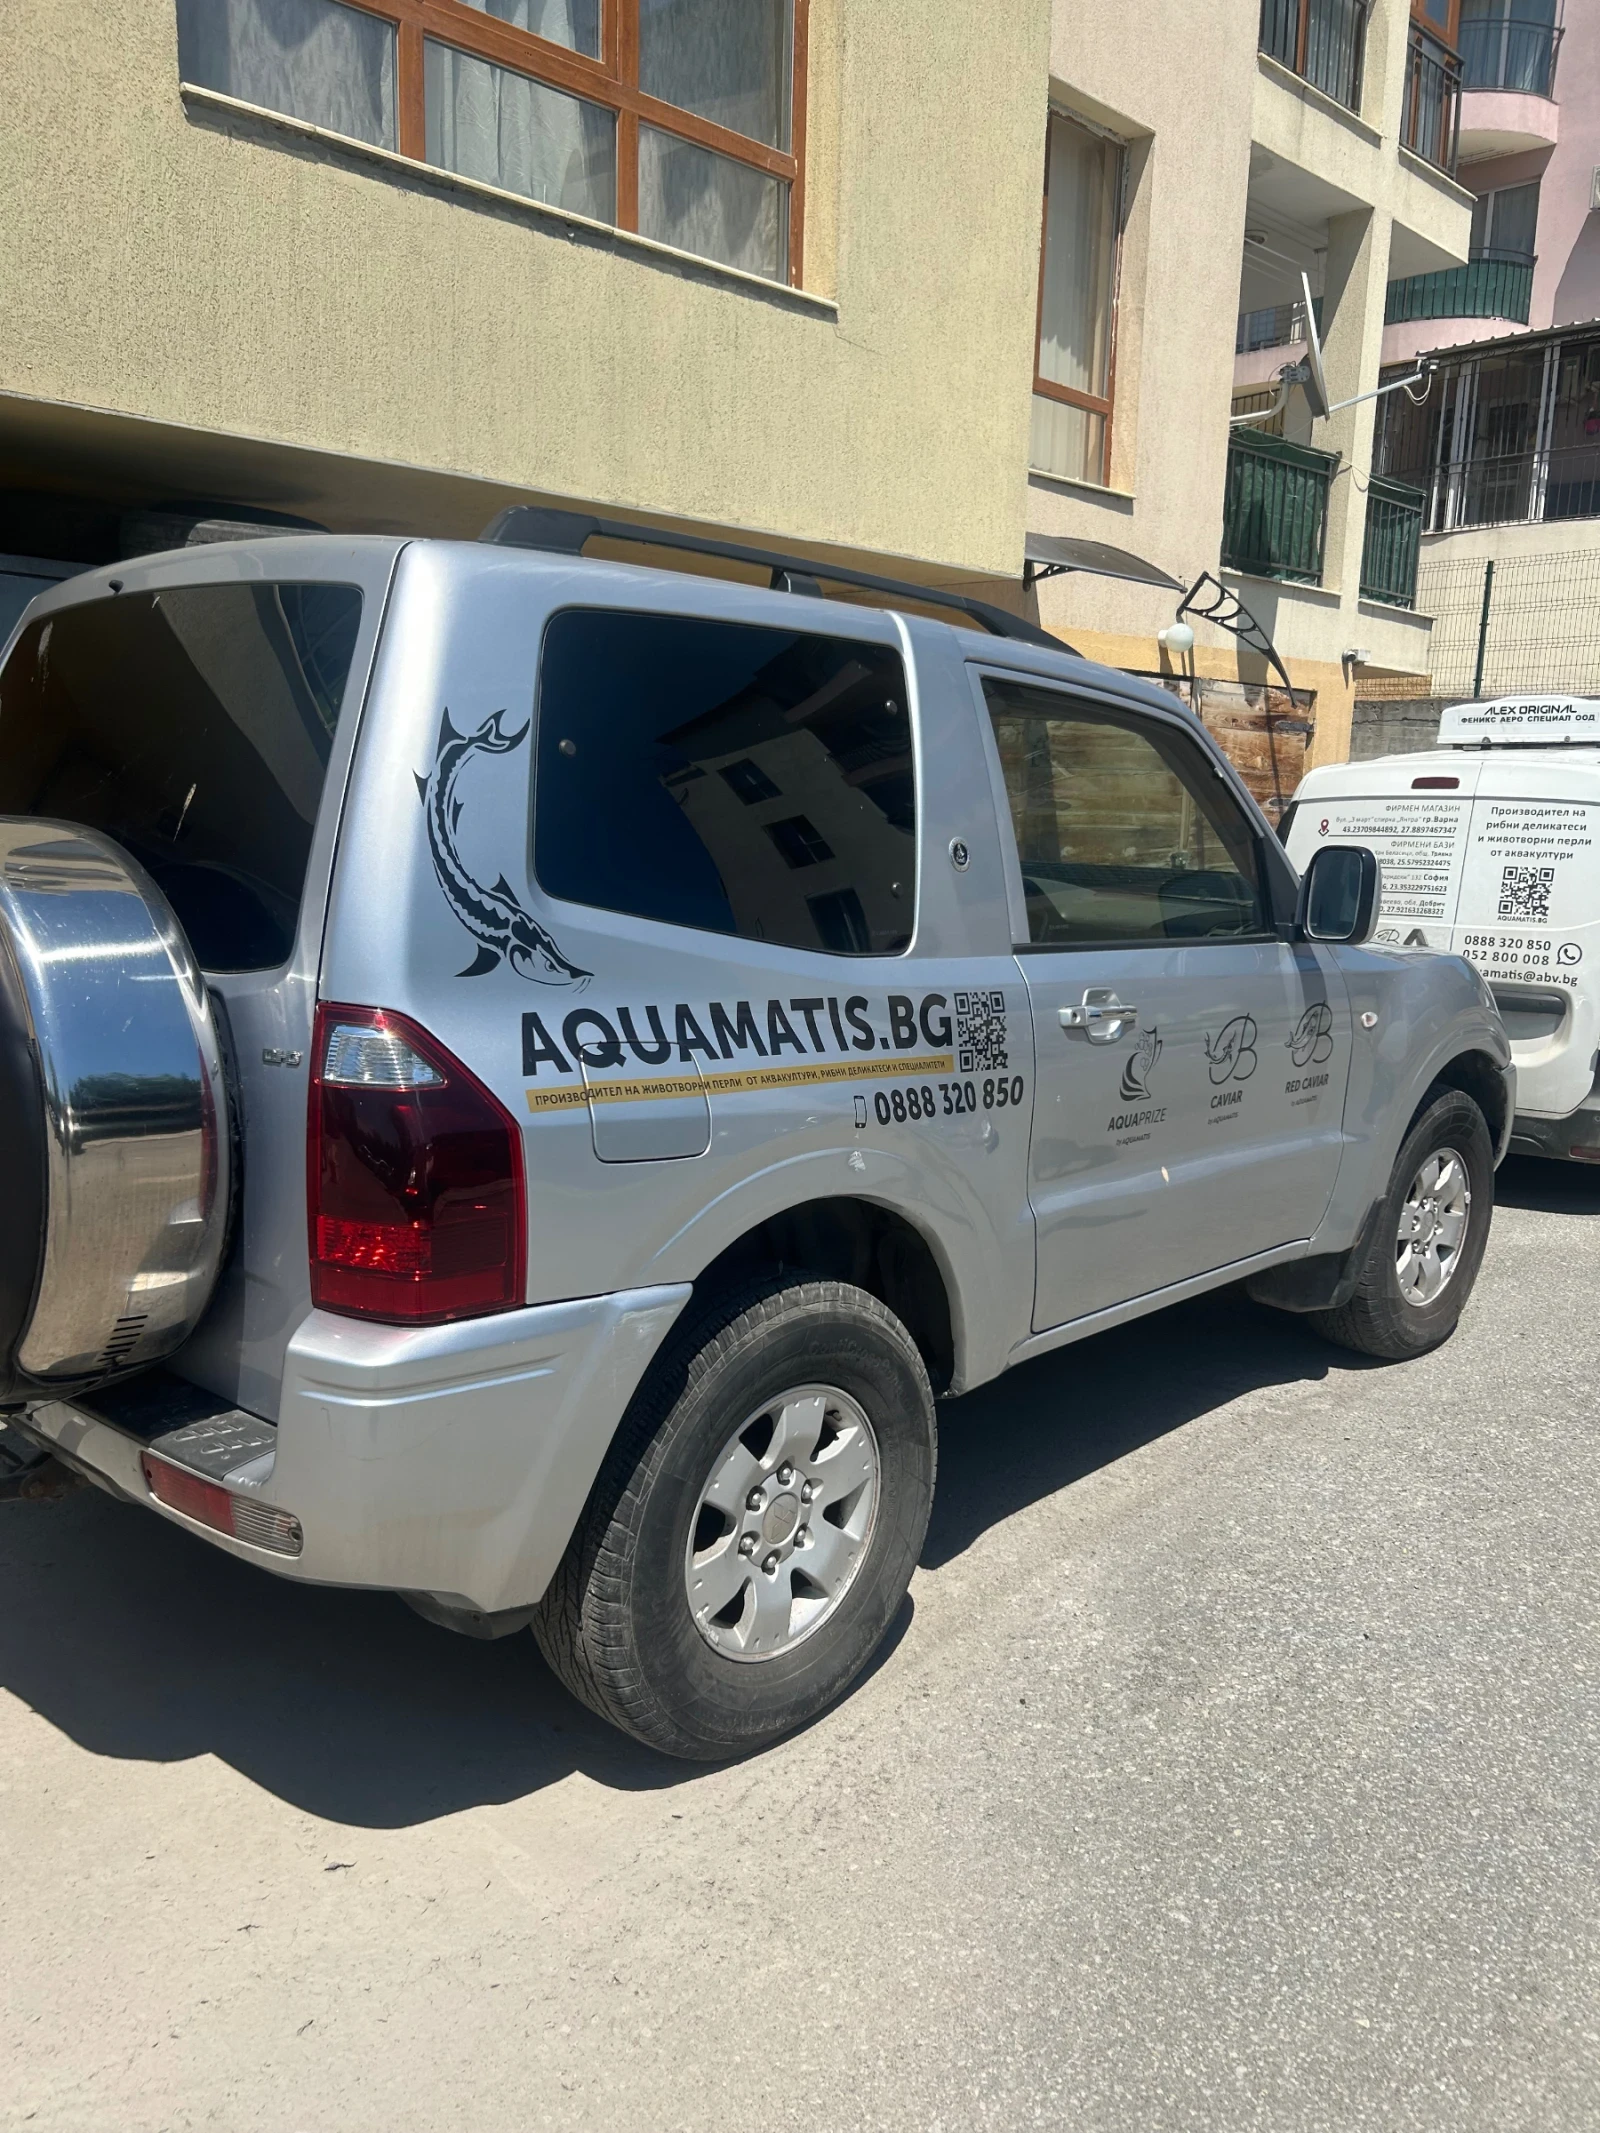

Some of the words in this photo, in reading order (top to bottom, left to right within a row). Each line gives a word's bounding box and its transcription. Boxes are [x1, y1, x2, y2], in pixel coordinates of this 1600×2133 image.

[1484, 706, 1516, 716] ALEX
[1519, 704, 1577, 714] ORIGINAL
[1528, 714, 1571, 723] СПЕЦИАЛ
[1575, 714, 1595, 722] ООД
[1422, 804, 1460, 812] МАГАЗИН
[1491, 806, 1569, 817] Производител
[1486, 820, 1520, 830] рибни
[1522, 822, 1586, 831] деликатеси
[1487, 836, 1554, 845] животворни
[1558, 838, 1592, 846] перли
[1504, 850, 1574, 860] аквакултури
[1423, 874, 1448, 882] София
[1497, 915, 1548, 924] AQUAMATIS.BG
[1464, 935, 1495, 947] 0888
[1499, 938, 1523, 949] 320
[1526, 940, 1551, 951] 850
[1463, 950, 1488, 960] 052
[1492, 952, 1518, 963] 800
[1522, 954, 1549, 966] 008
[1480, 968, 1578, 987] amatis@abv.bg
[522, 993, 953, 1076] AQUAMATIS.BG
[535, 1086, 622, 1106] ПРОИЗВОДИТЕЛ
[625, 1084, 640, 1096] НА
[641, 1080, 711, 1095] ЖИВОТВОРНИ
[712, 1078, 743, 1090] ПЕРЛИ
[746, 1076, 758, 1086] ОТ
[760, 1070, 820, 1086] АКВАКУЛТУРИ,
[821, 1067, 847, 1079] РИБНИ
[848, 1064, 892, 1076] ДЕЛИКАТЕСИ
[898, 1060, 946, 1072] СПЕЦИАЛИТЕТИ
[1285, 1079, 1300, 1094] RED
[1302, 1073, 1329, 1090] CAVIAR
[874, 1086, 936, 1126] 0888
[938, 1080, 976, 1116] 320
[982, 1076, 1024, 1110] 850
[1210, 1090, 1243, 1109] CAVIAR
[1107, 1107, 1168, 1132] AQUAPRIZE
[1122, 1132, 1152, 1146] AQUAMATIS
